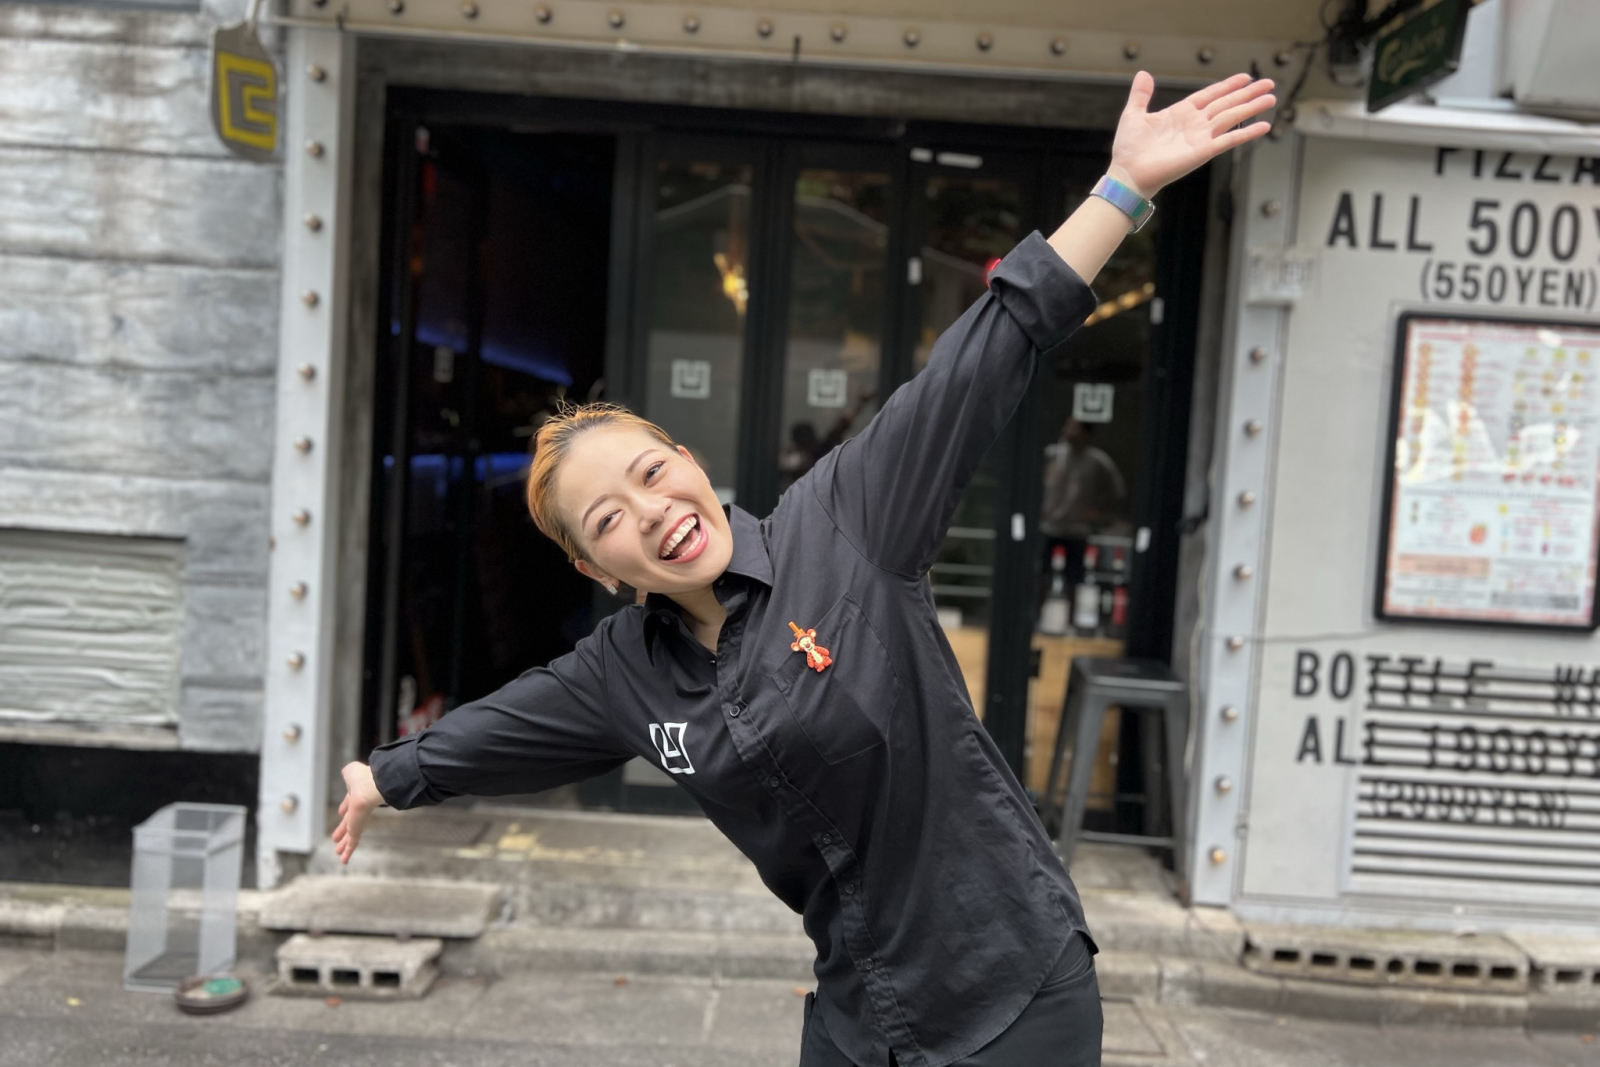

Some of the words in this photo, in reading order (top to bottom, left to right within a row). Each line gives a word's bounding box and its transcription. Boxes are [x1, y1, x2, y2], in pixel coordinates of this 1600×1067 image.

[1326, 190, 1434, 252] ALL
[1467, 199, 1600, 262] 500
[1421, 258, 1598, 311] (550YEN)
[1293, 649, 1492, 709] BOTTLE
[1555, 662, 1600, 717] W
